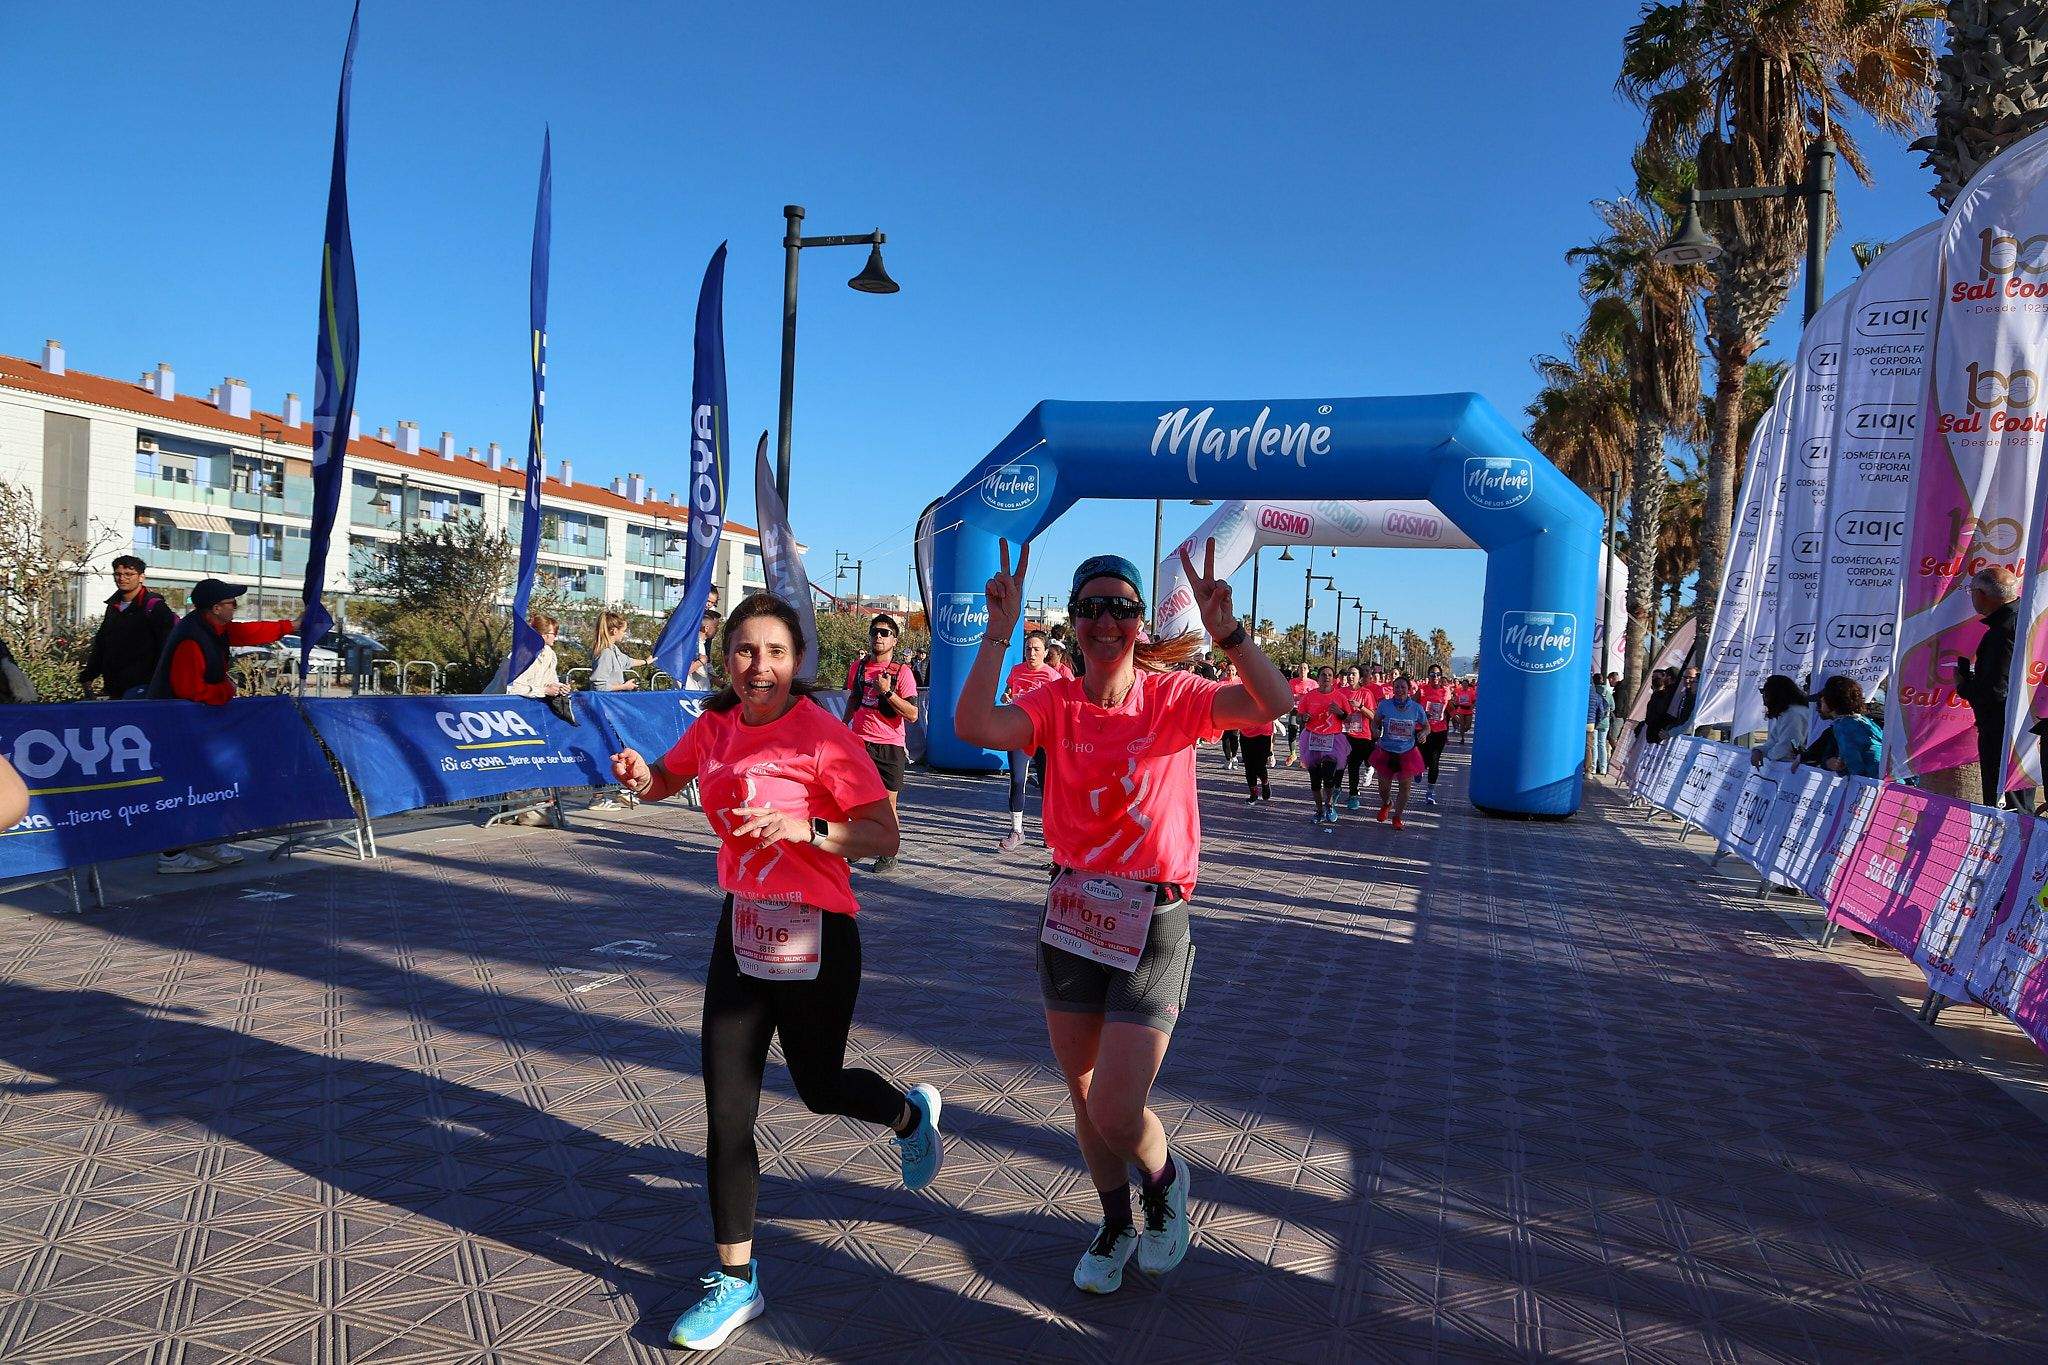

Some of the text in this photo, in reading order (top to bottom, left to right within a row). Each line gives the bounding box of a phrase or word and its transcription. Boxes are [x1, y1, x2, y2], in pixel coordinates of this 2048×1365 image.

[1951, 278, 1997, 302] Sal
[1975, 304, 2017, 314] Desde
[1937, 412, 1982, 434] Sal
[1961, 437, 2034, 447] Desde 1925
[692, 404, 721, 548] GOYA
[985, 474, 1034, 497] Marlene
[1469, 469, 1528, 495] Marlene
[1261, 509, 1309, 536] COSMO
[1387, 512, 1438, 538] COSMO
[1919, 556, 1962, 578] Sal
[939, 605, 989, 631] Marlene
[1505, 624, 1571, 655] Marlene
[1545, 658, 1565, 668] ALPES
[1901, 686, 1941, 707] Sal
[435, 710, 537, 743] GOYA
[0, 725, 153, 779] OYA
[460, 759, 472, 770] es
[472, 756, 504, 769] GOYA
[531, 756, 546, 771] que
[547, 756, 559, 765] ser
[118, 803, 150, 826] que
[155, 796, 183, 811] ser
[188, 782, 240, 807] bueno!
[1084, 883, 1120, 898] ASTURIANA
[1081, 909, 1117, 931] 016
[755, 925, 789, 942] 016
[1051, 933, 1082, 949] OYSHO
[1099, 951, 1128, 963] Santander
